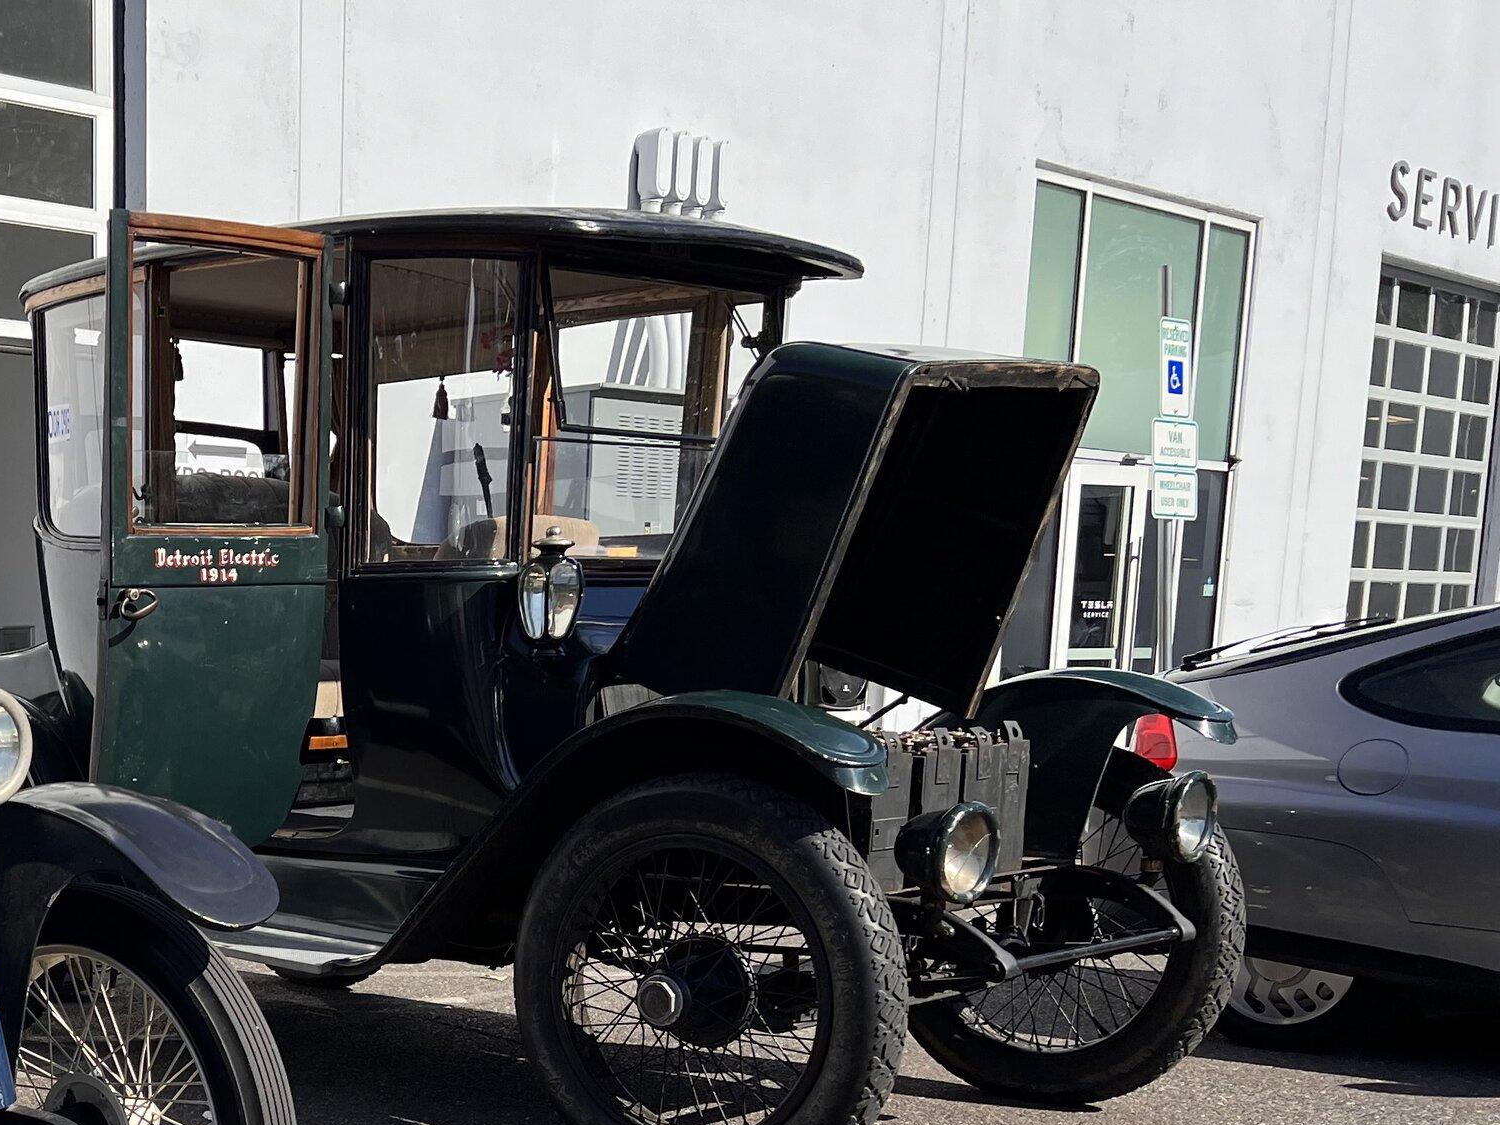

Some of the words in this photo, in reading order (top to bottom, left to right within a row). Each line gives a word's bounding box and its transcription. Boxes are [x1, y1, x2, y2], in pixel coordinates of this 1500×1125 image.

[1386, 160, 1500, 249] SERVI
[1168, 431, 1183, 444] VAN
[1161, 497, 1175, 507] USER
[1176, 498, 1189, 508] ONLY
[155, 547, 213, 567] Detroit
[219, 547, 279, 567] Electric
[200, 568, 238, 582] 1914
[1081, 600, 1113, 609] TESLA
